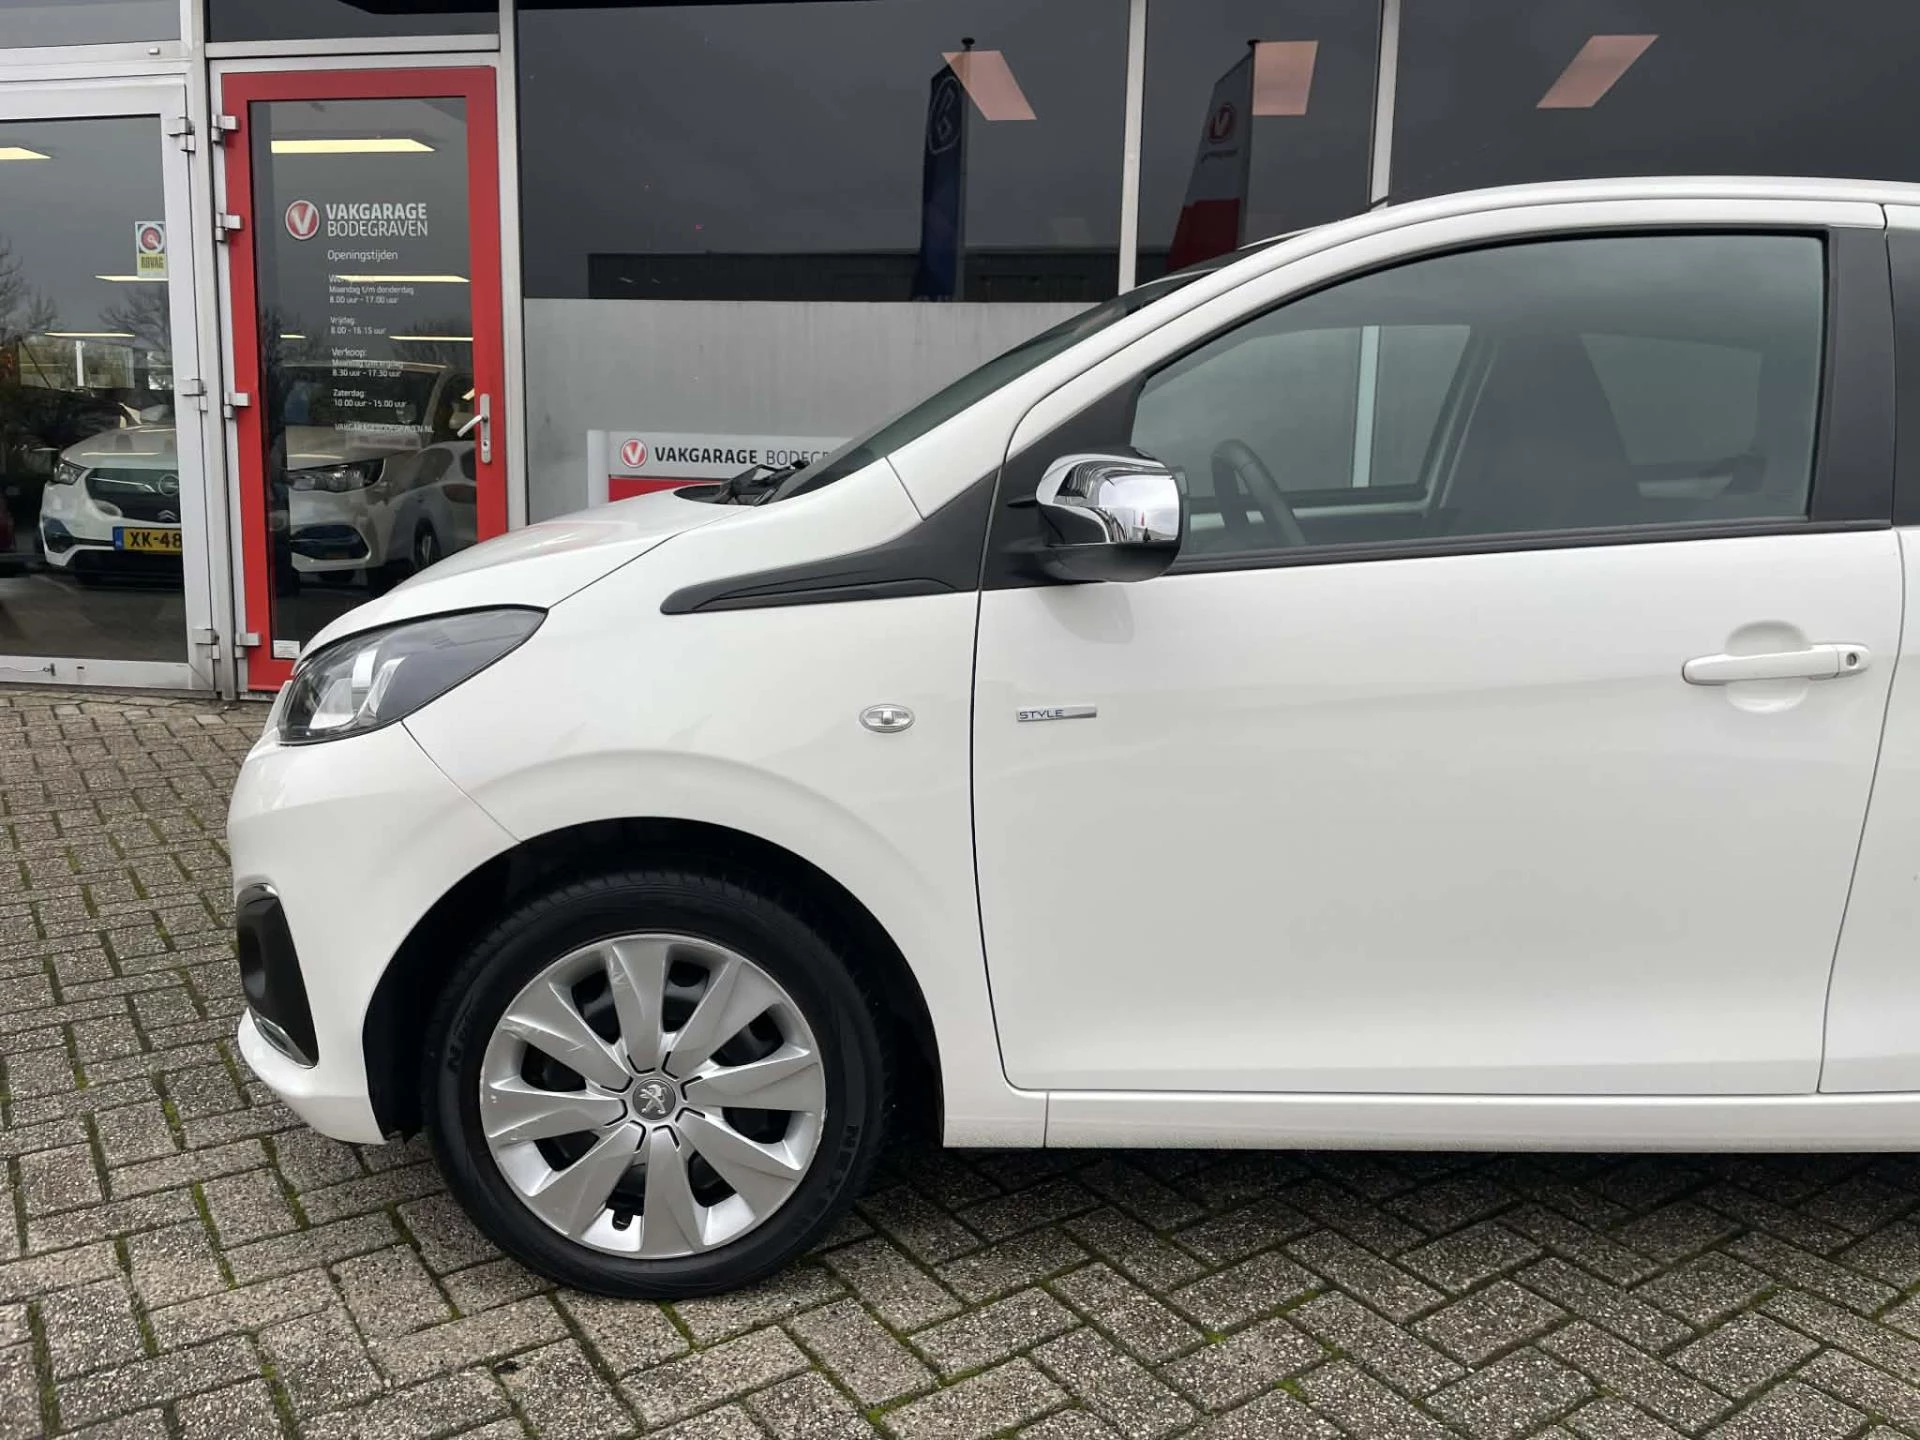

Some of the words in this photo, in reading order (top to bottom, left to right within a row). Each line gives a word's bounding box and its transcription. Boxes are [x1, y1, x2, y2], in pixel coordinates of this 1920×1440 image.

[326, 202, 428, 220] VAKGARAGE
[327, 220, 428, 237] BODEGRAVEN
[327, 249, 399, 263] Openingstijden
[377, 286, 414, 296] donderdag
[366, 296, 385, 304] 17.00
[368, 369, 387, 377] 17.30
[334, 399, 353, 407] 10.00
[654, 446, 758, 465] VAKGARAGE
[129, 530, 182, 548] XK-48
[1019, 709, 1064, 720] STYLE
